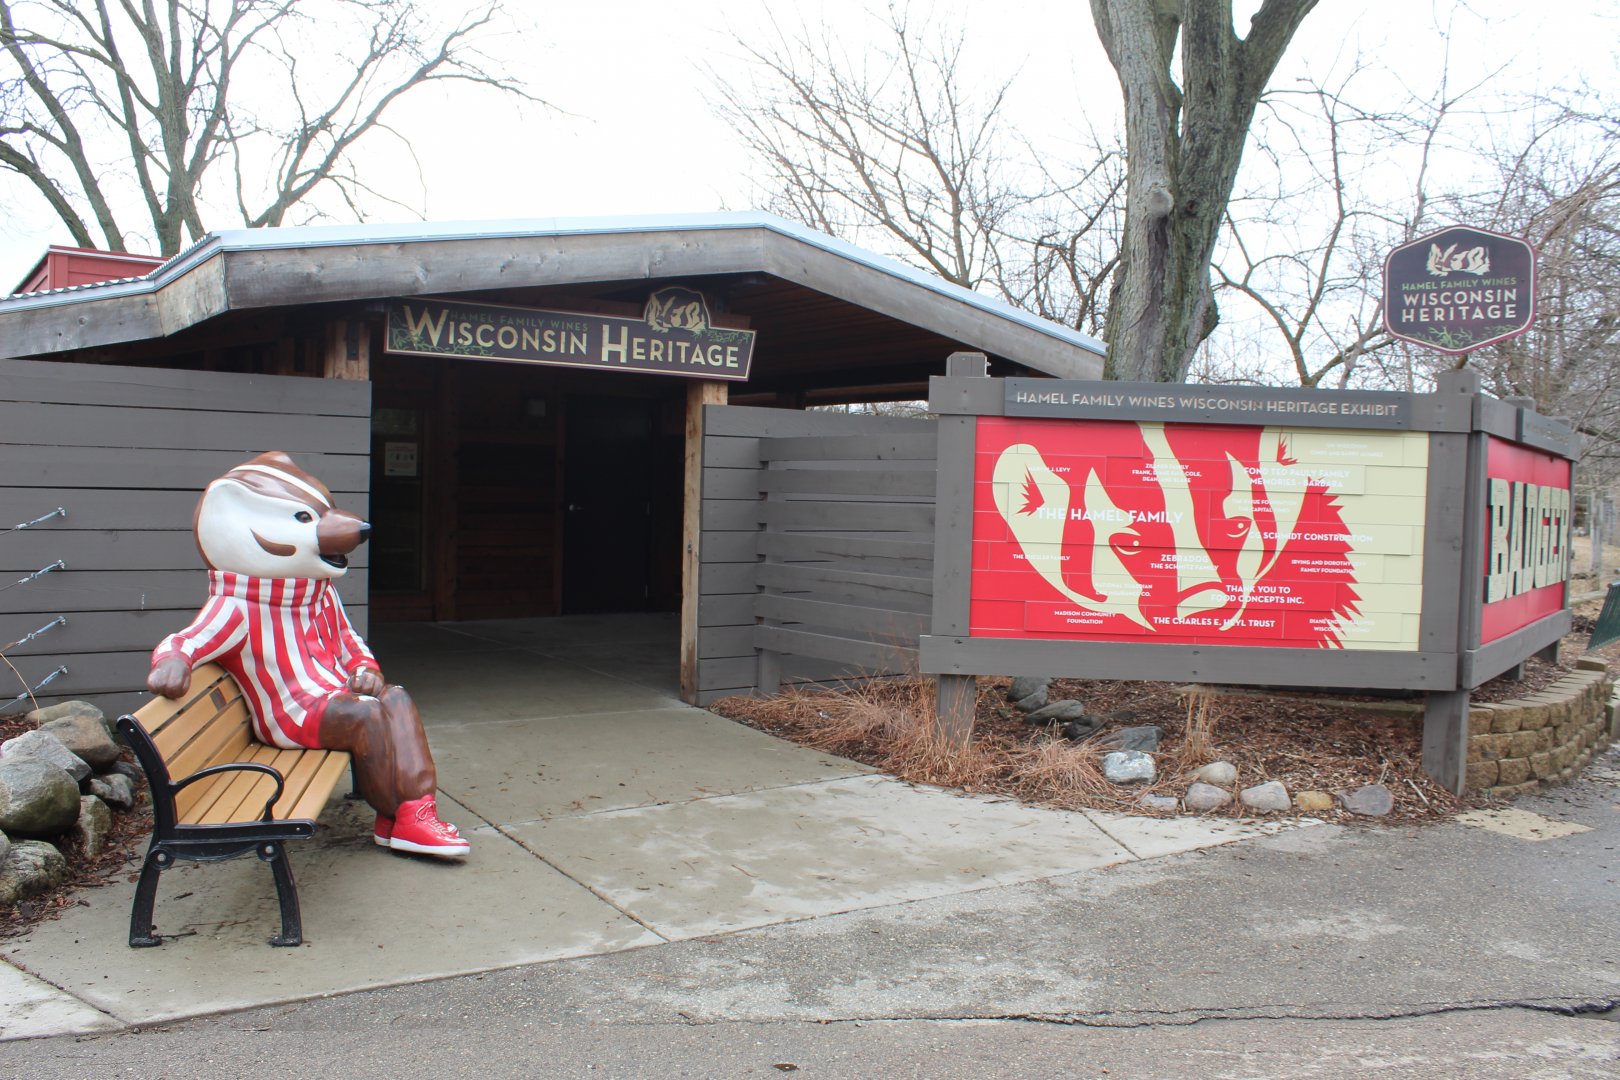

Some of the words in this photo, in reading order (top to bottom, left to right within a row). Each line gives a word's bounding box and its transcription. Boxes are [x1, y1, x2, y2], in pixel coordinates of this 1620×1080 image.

[1402, 282, 1437, 291] HAMEL
[1440, 279, 1479, 289] FAMILY
[1482, 277, 1517, 286] WINES
[1403, 288, 1517, 307] WISCONSIN
[451, 311, 495, 324] HAMEL
[500, 315, 546, 329] FAMILY
[551, 320, 588, 332] WINES
[1402, 304, 1517, 323] HERITAGE
[1016, 391, 1068, 405] HAMEL
[1072, 393, 1124, 407] FAMILY
[1129, 396, 1175, 408] WINES
[1180, 397, 1264, 411] WISCONSIN
[1267, 400, 1338, 414] HERITAGE
[1341, 403, 1398, 416] EXHIBIT
[1037, 507, 1065, 520] THE
[1071, 508, 1124, 521] HAMEL
[1128, 509, 1183, 523] FAMILY
[1263, 532, 1302, 540] SCHMIDT
[1304, 533, 1373, 543] CONSTRUCTION
[1484, 477, 1570, 603] BADGER
[1226, 584, 1255, 594] THANK
[1257, 585, 1276, 594] YOU
[1278, 586, 1291, 594] TO
[1211, 594, 1237, 602] FOOD
[1238, 595, 1285, 604] CONCEPTS
[1287, 596, 1304, 604] INC.
[1153, 616, 1170, 625] THE
[1172, 617, 1212, 626] CHARLES
[1214, 618, 1222, 626] E.
[1248, 619, 1275, 628] TRUST
